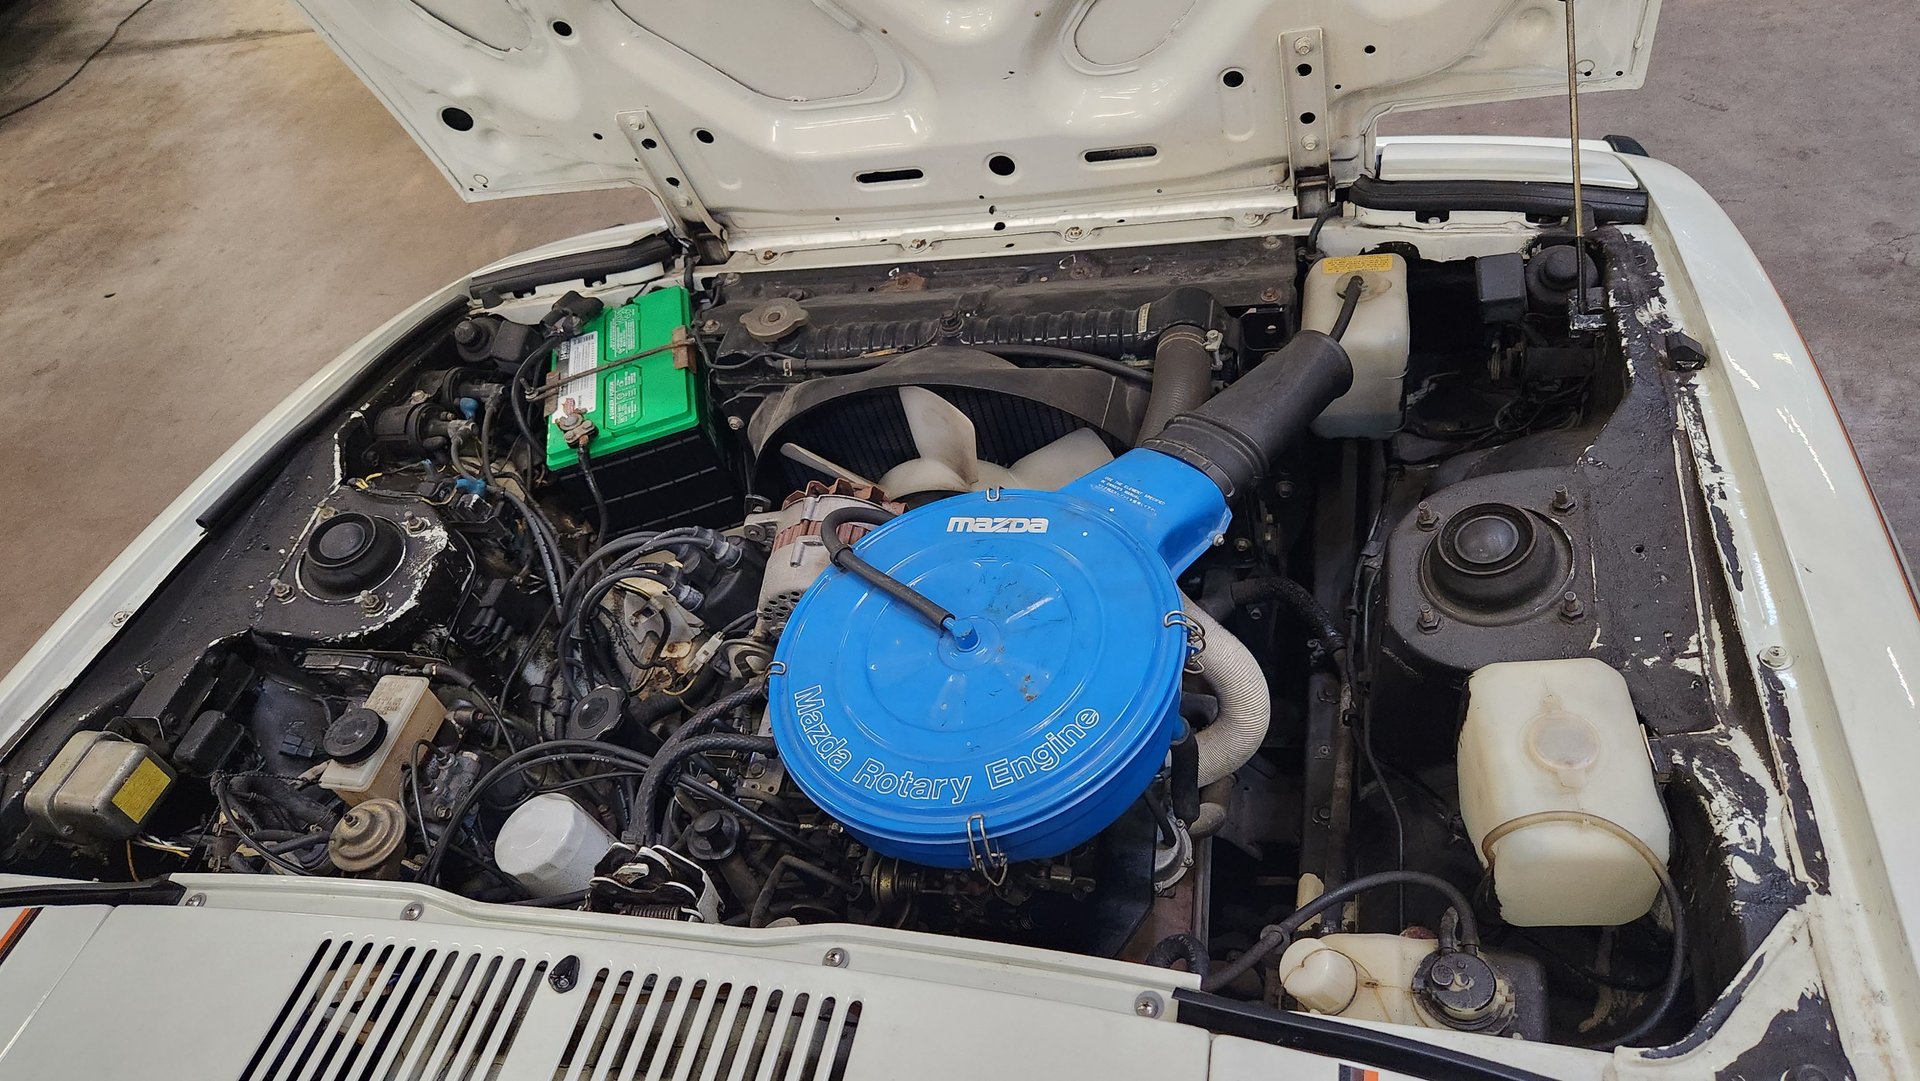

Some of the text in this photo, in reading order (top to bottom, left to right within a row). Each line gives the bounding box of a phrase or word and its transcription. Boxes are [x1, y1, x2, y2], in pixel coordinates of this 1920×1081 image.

[946, 516, 1050, 534] mazda
[793, 684, 1101, 804] Mazda Rotary Engine
